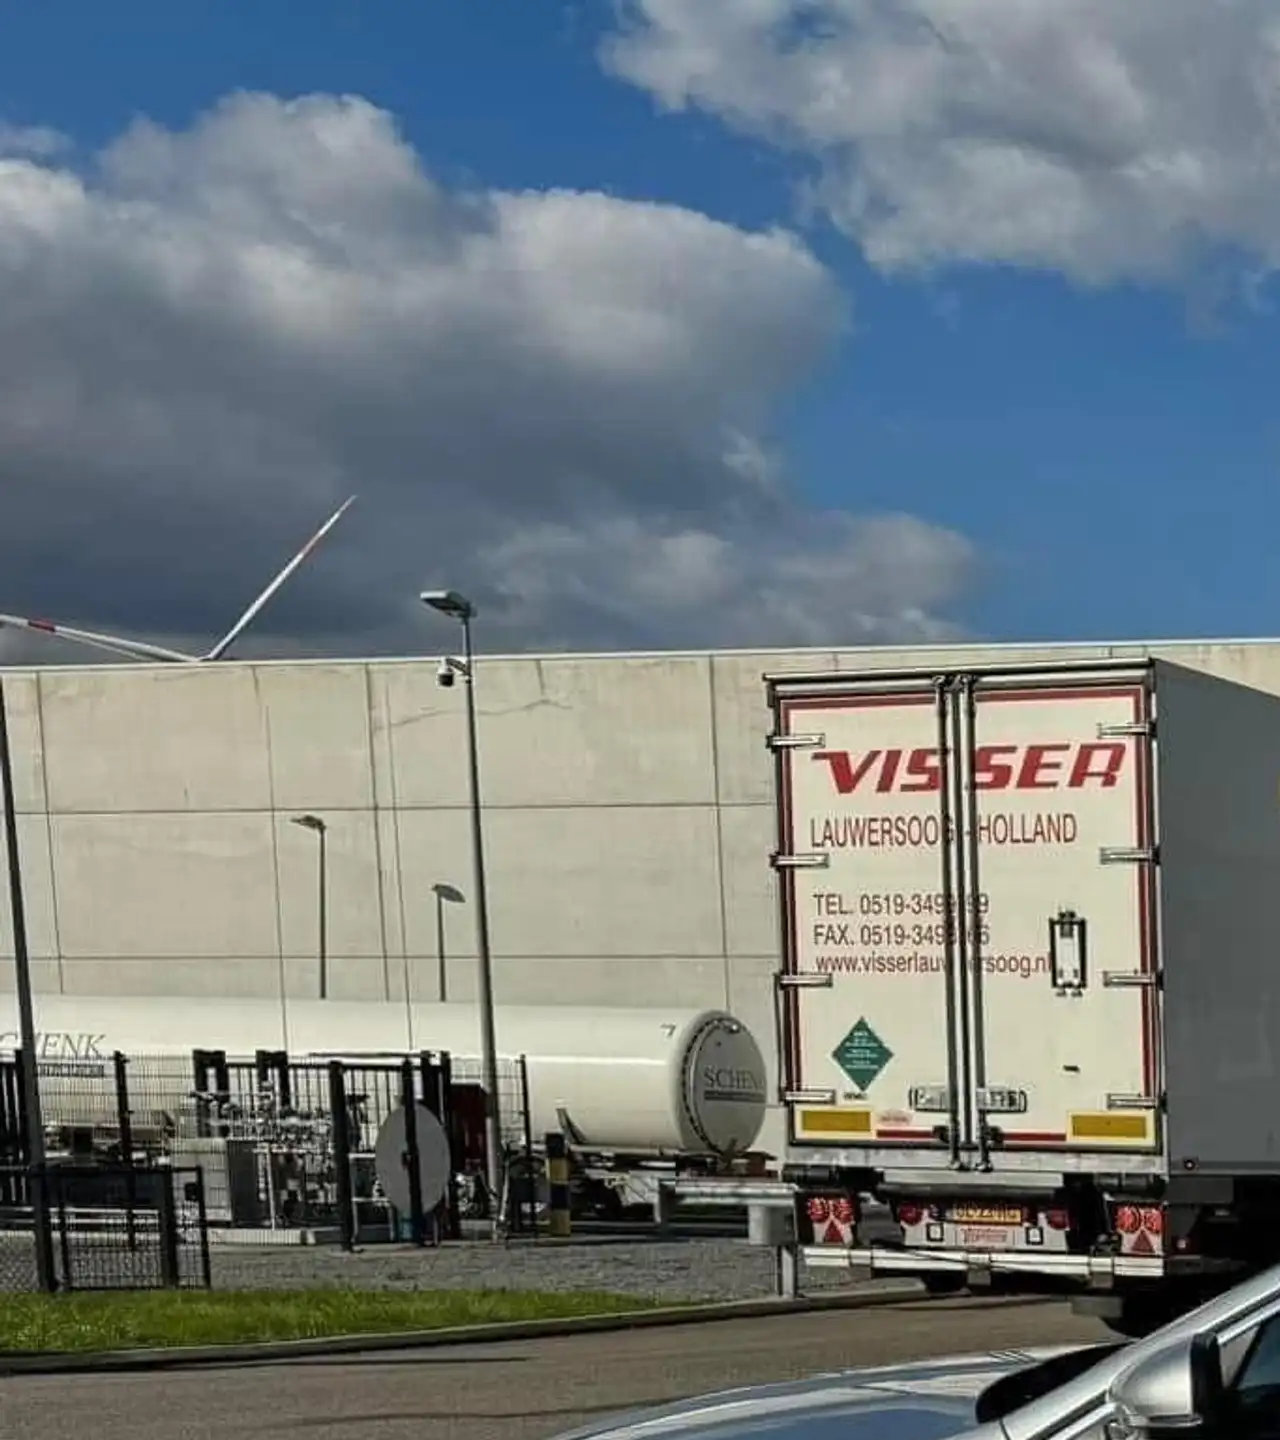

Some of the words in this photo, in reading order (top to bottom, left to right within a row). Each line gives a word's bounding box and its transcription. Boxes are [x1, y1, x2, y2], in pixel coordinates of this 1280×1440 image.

[811, 743, 1126, 794] VISSER
[978, 813, 1077, 844] HOLLAND
[813, 893, 852, 916] TEL.
[813, 924, 855, 946] FAX.
[704, 1066, 765, 1090] SCHEN
